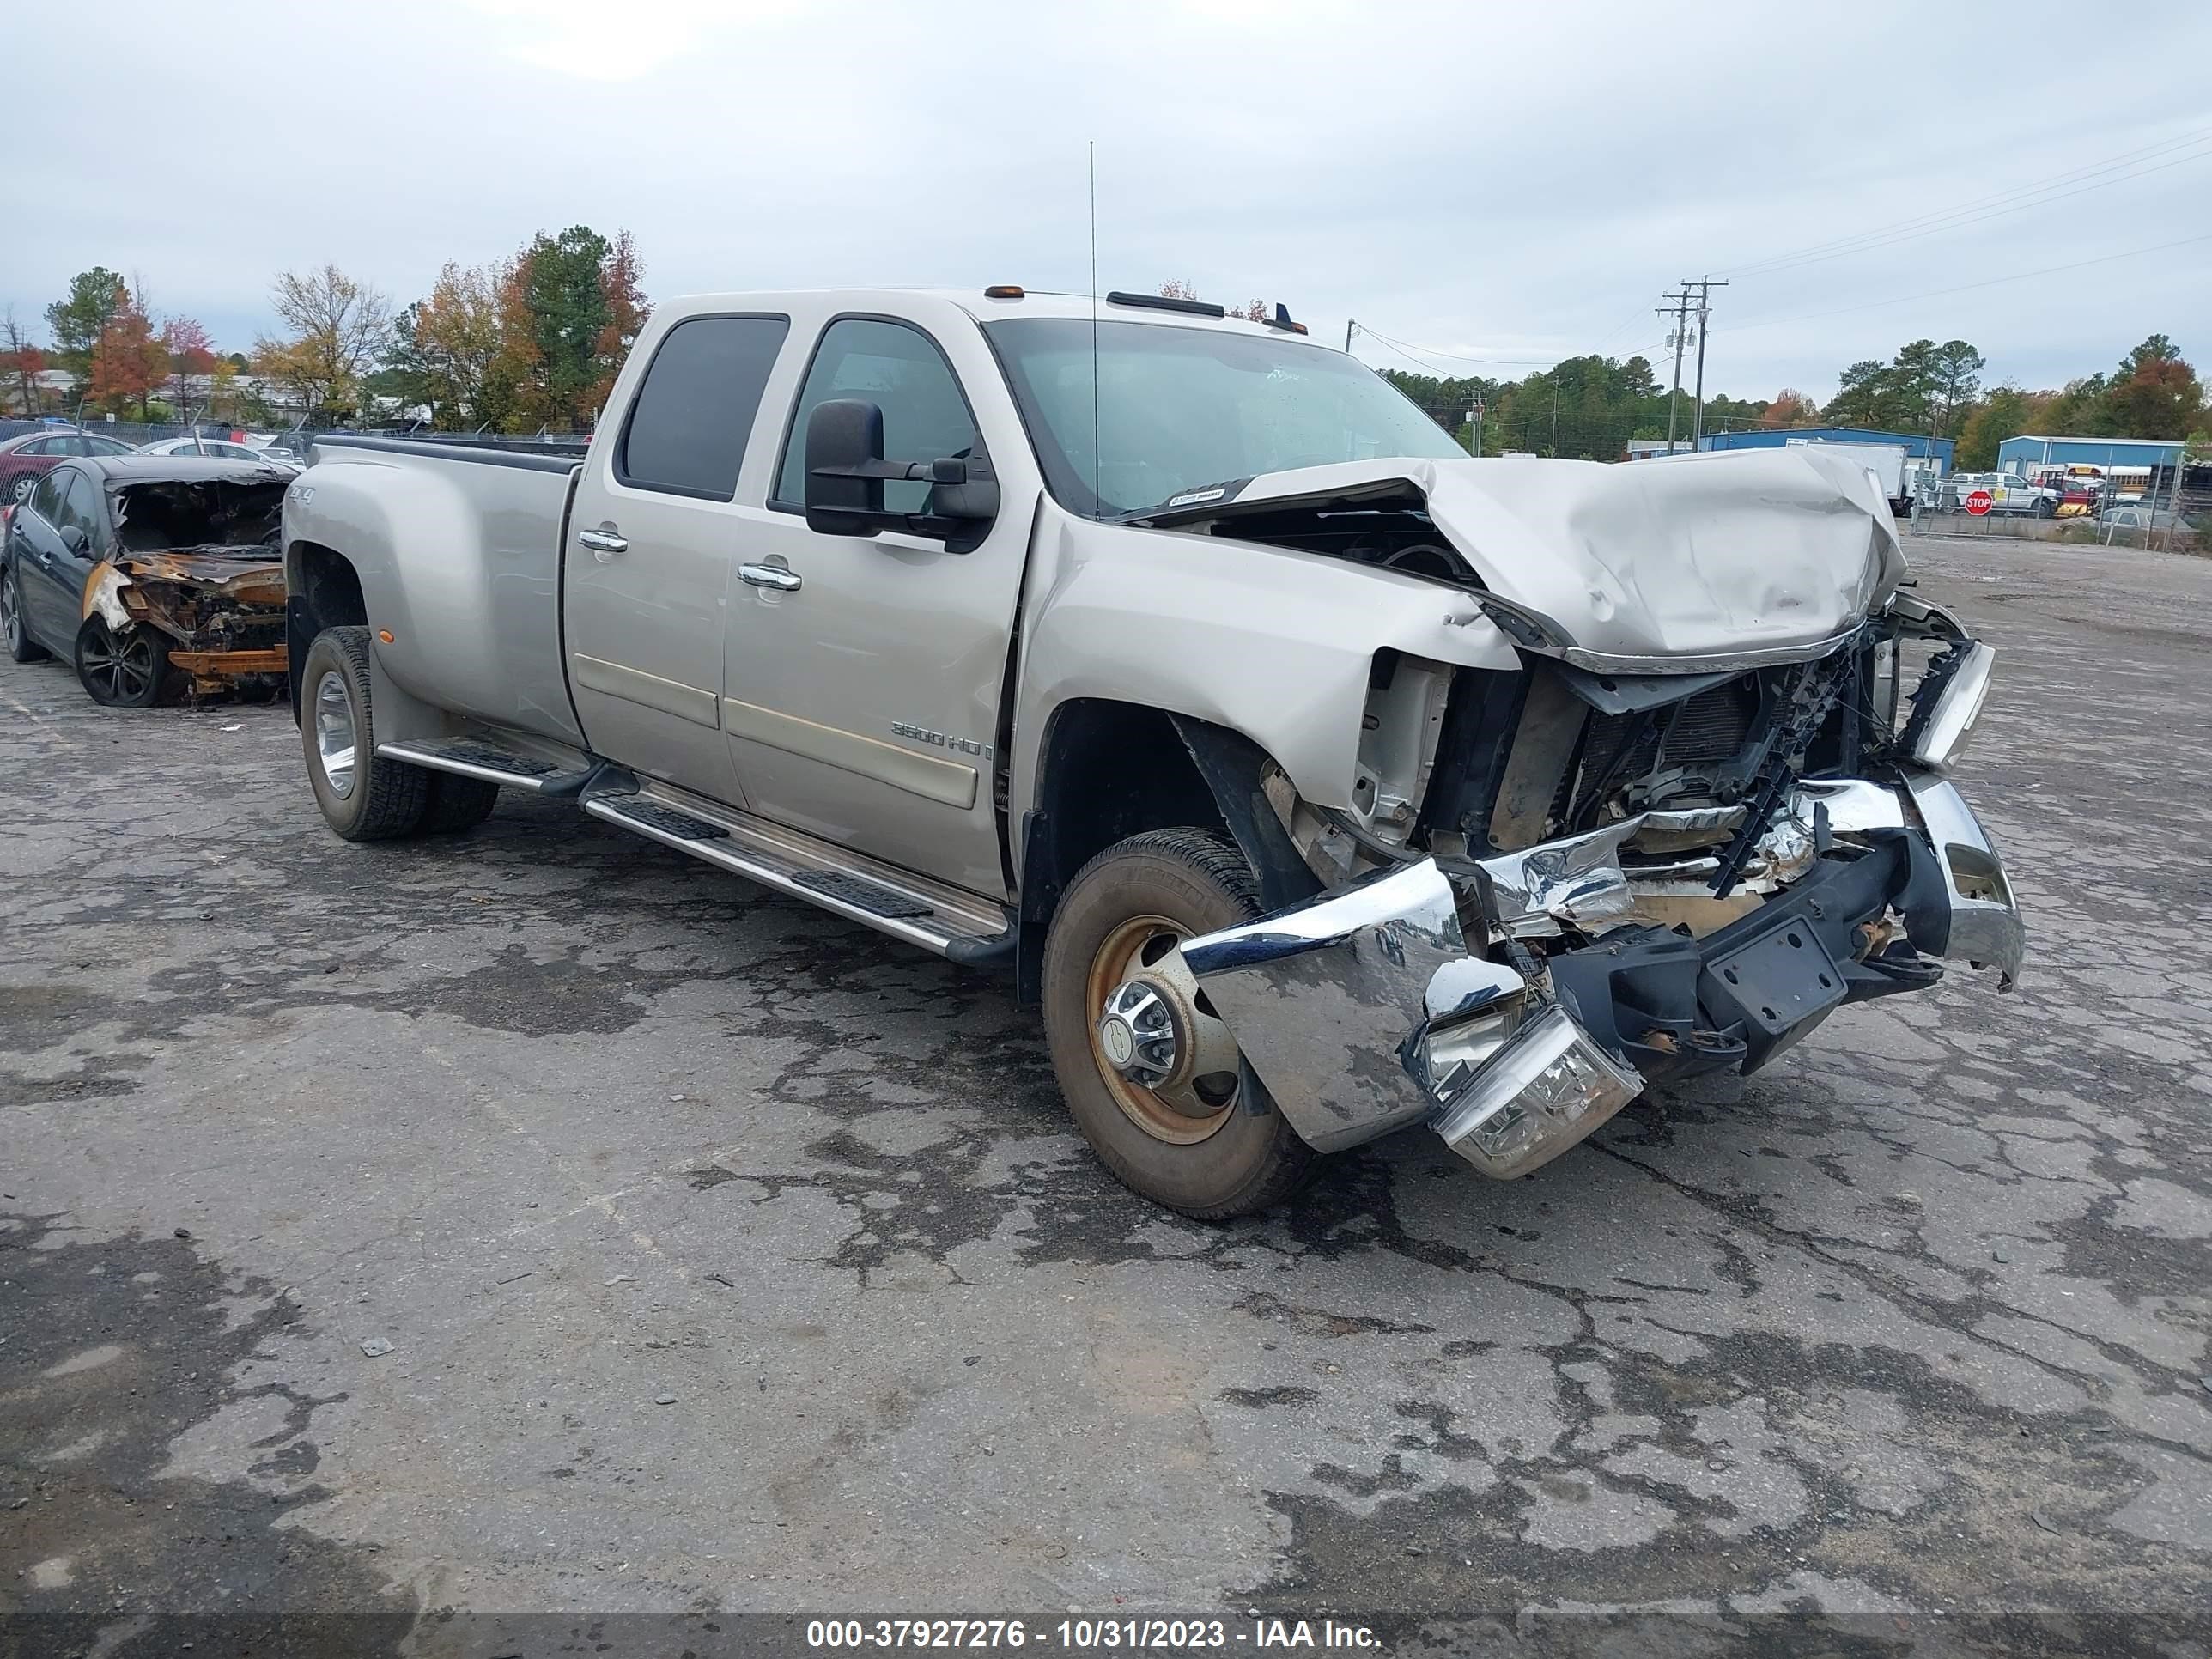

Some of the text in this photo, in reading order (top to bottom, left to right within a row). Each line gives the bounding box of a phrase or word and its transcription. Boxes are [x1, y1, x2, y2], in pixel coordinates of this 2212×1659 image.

[1966, 498, 1991, 508] STOP
[891, 720, 945, 746] 3500
[948, 736, 981, 756] HD
